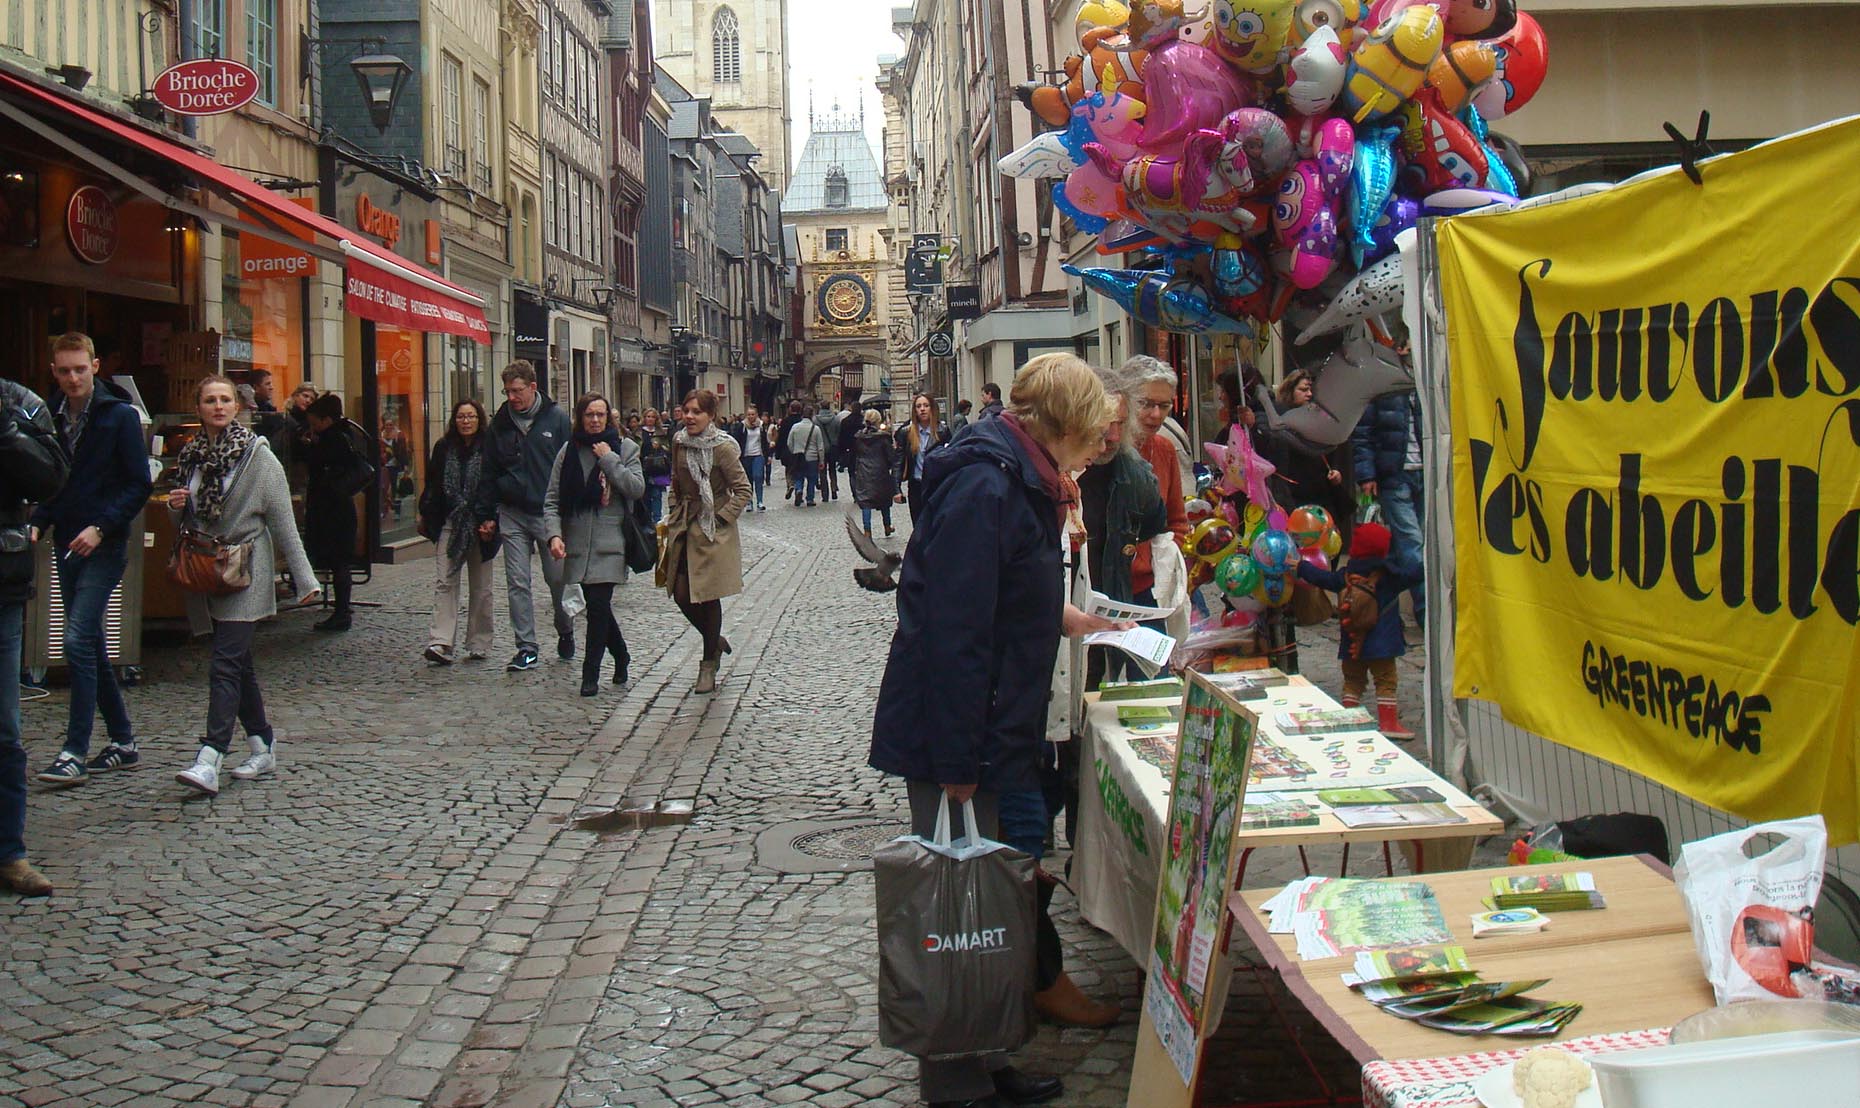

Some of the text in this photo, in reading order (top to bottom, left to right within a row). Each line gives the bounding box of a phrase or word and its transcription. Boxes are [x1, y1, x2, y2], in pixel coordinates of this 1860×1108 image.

[168, 66, 246, 92] Brioche
[179, 88, 235, 109] Dorée
[77, 195, 113, 232] Brioche
[356, 191, 400, 250] Orange
[244, 255, 308, 274] orange
[348, 278, 367, 298] SALON
[366, 284, 374, 301] DE
[374, 286, 384, 304] THE
[950, 297, 977, 307] minelli
[1494, 258, 1860, 472] Sauvons
[1582, 640, 1771, 755] GREENPEACE
[927, 928, 1006, 952] DAMART
